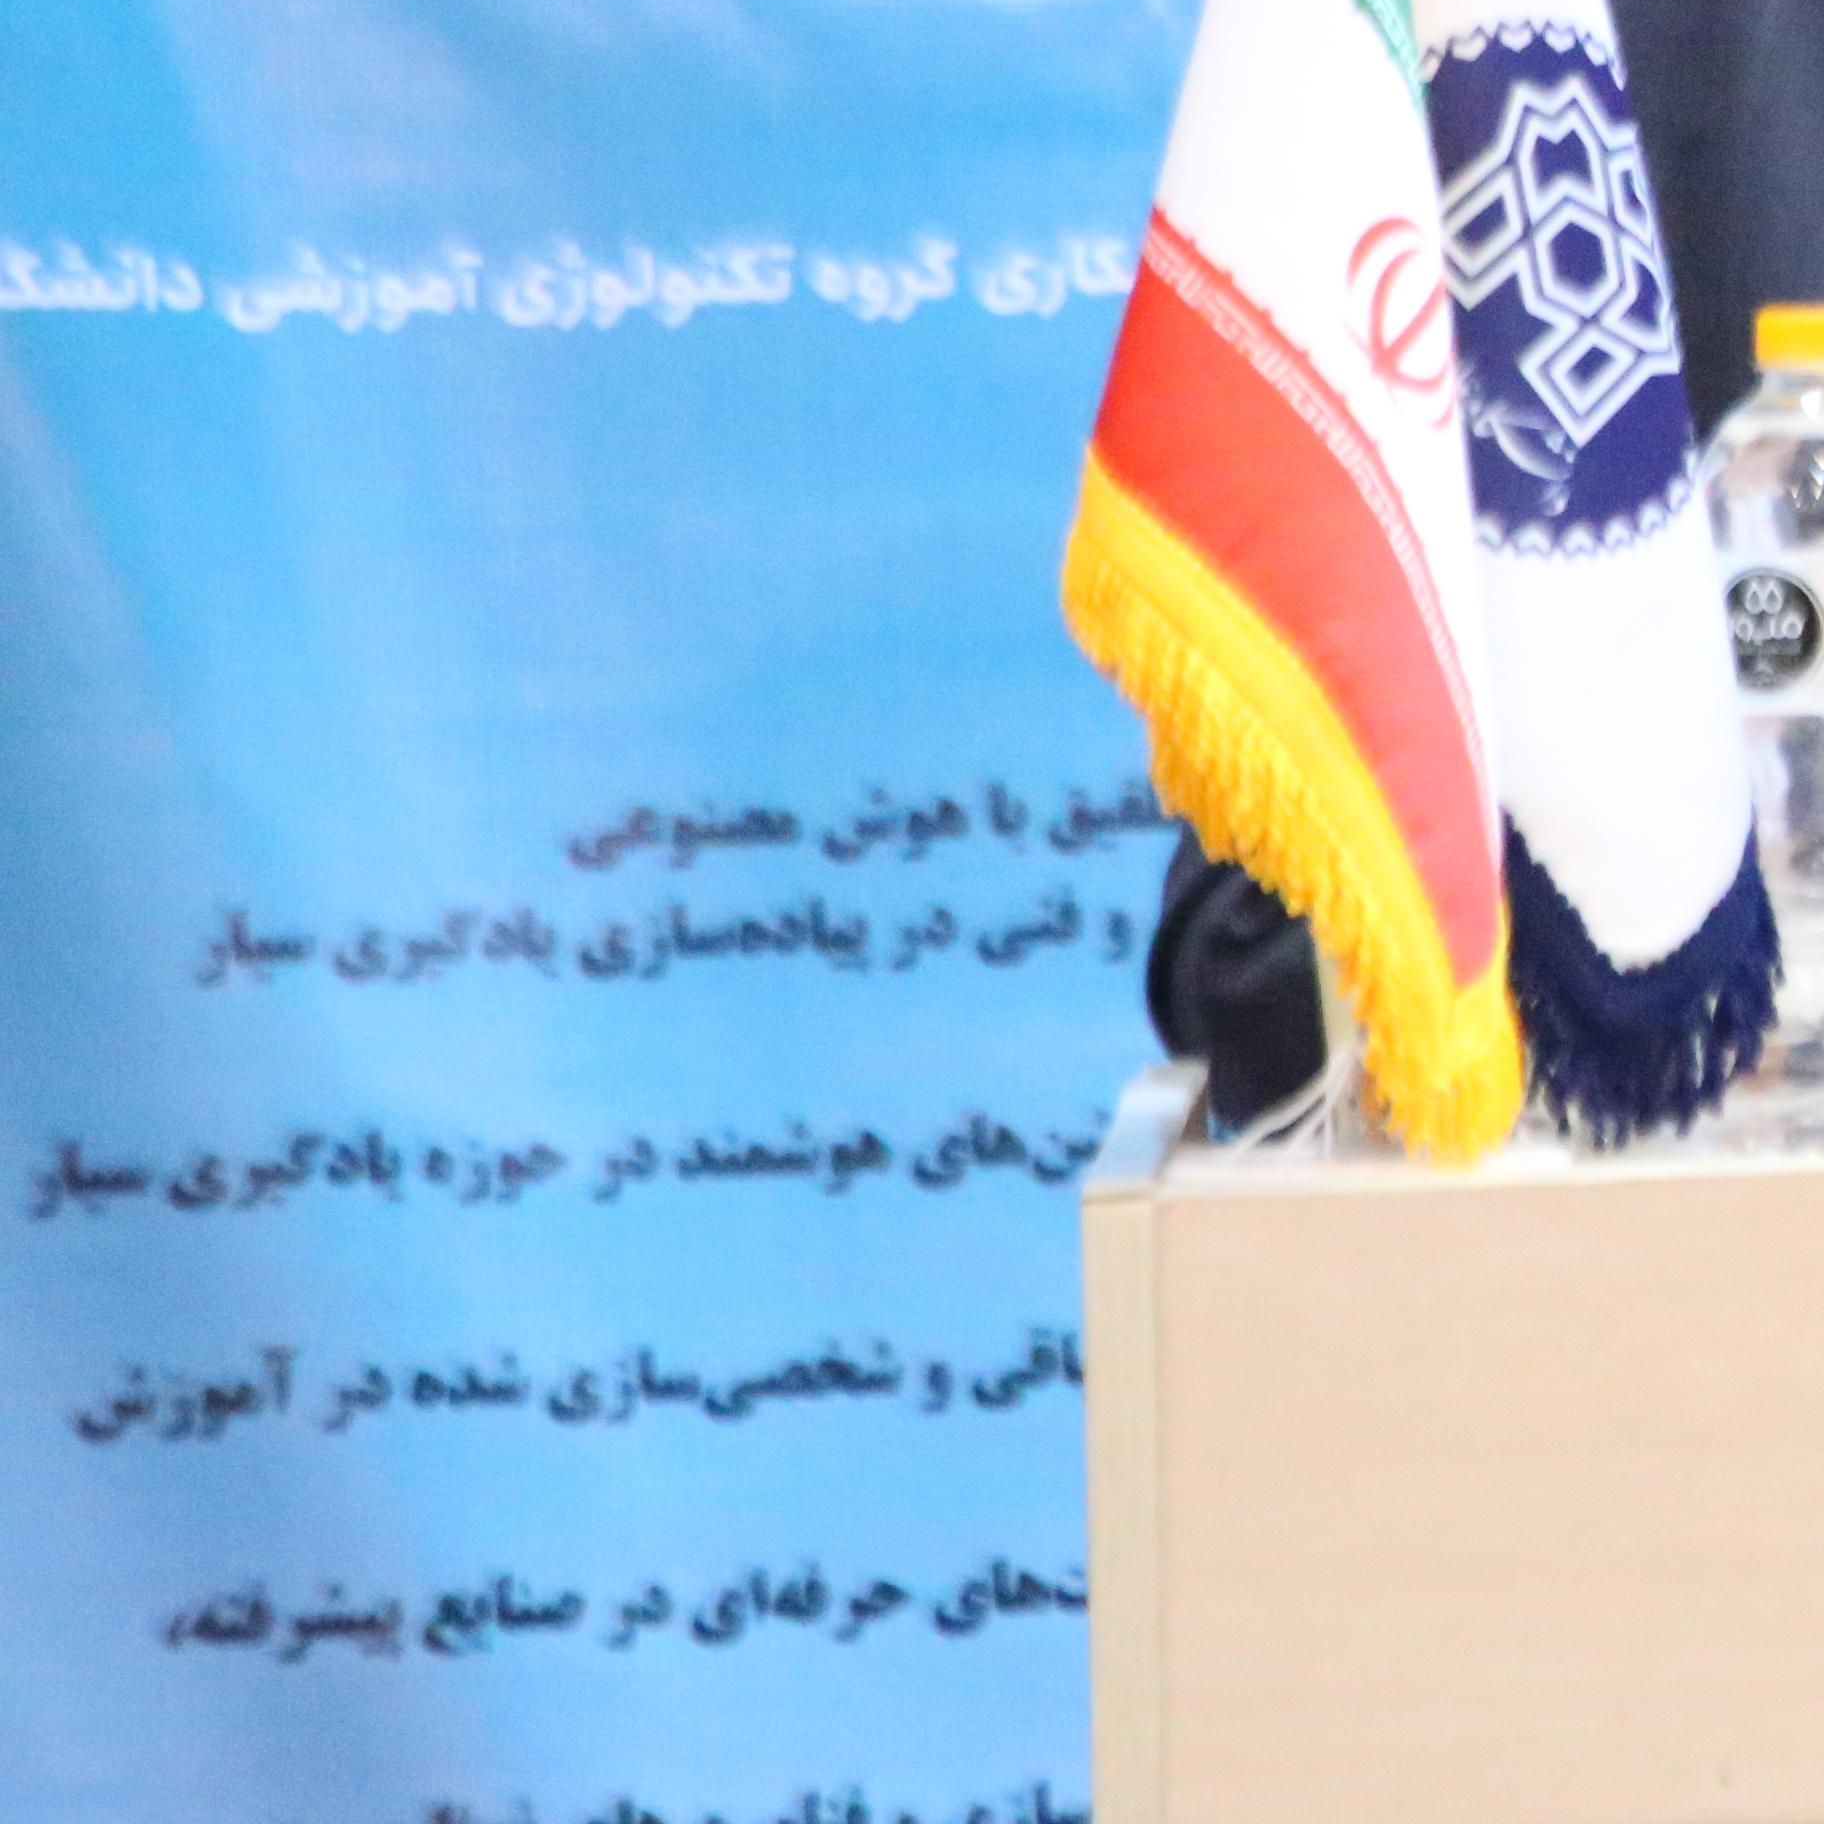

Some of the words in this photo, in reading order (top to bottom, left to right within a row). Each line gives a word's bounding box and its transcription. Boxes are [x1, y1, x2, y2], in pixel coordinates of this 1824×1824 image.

[218, 234, 484, 333] آموزشی
[496, 236, 797, 328] تکنولوژی
[810, 228, 957, 322] گروه
[568, 798, 798, 868] مصنوعی
[818, 784, 970, 863] هوش
[983, 779, 1030, 851] با
[195, 904, 312, 988] سیار
[890, 906, 955, 971] در
[975, 888, 1083, 966] فنی
[1103, 909, 1132, 964] و
[28, 1131, 150, 1221] سیار
[168, 1126, 402, 1211] یادگیری
[423, 1139, 568, 1208] حوزه
[592, 1134, 657, 1204] در
[675, 1113, 890, 1196] هوشمند
[75, 1341, 298, 1444] آموزش
[320, 1359, 392, 1434] در
[412, 1348, 527, 1411] شده
[920, 1358, 952, 1414] و
[422, 1571, 588, 1656] صنایع
[605, 1586, 672, 1651] در
